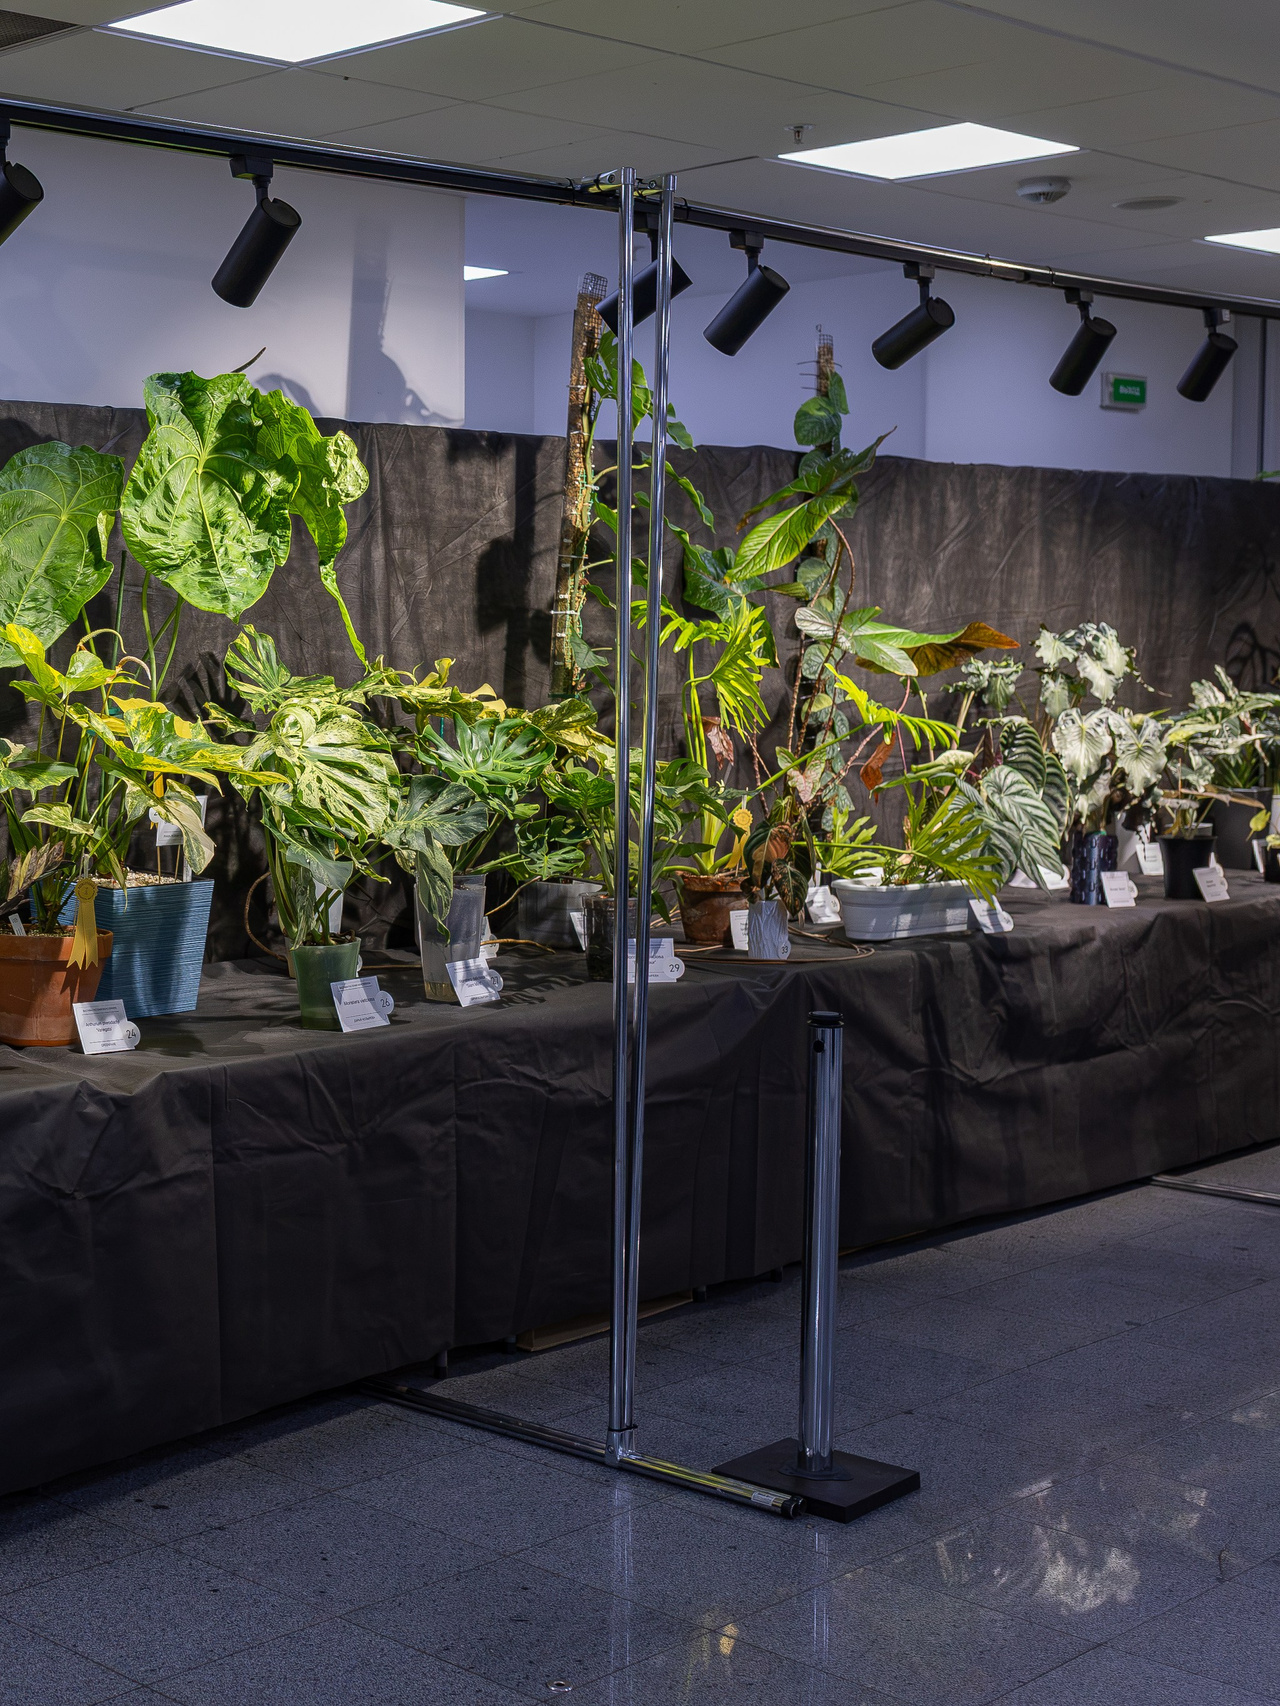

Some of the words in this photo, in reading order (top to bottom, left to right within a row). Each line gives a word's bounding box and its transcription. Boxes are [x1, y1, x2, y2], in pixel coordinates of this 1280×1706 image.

[669, 964, 680, 973] 29
[491, 976, 498, 985] 27
[380, 998, 390, 1008] 26
[126, 1029, 136, 1039] 24
